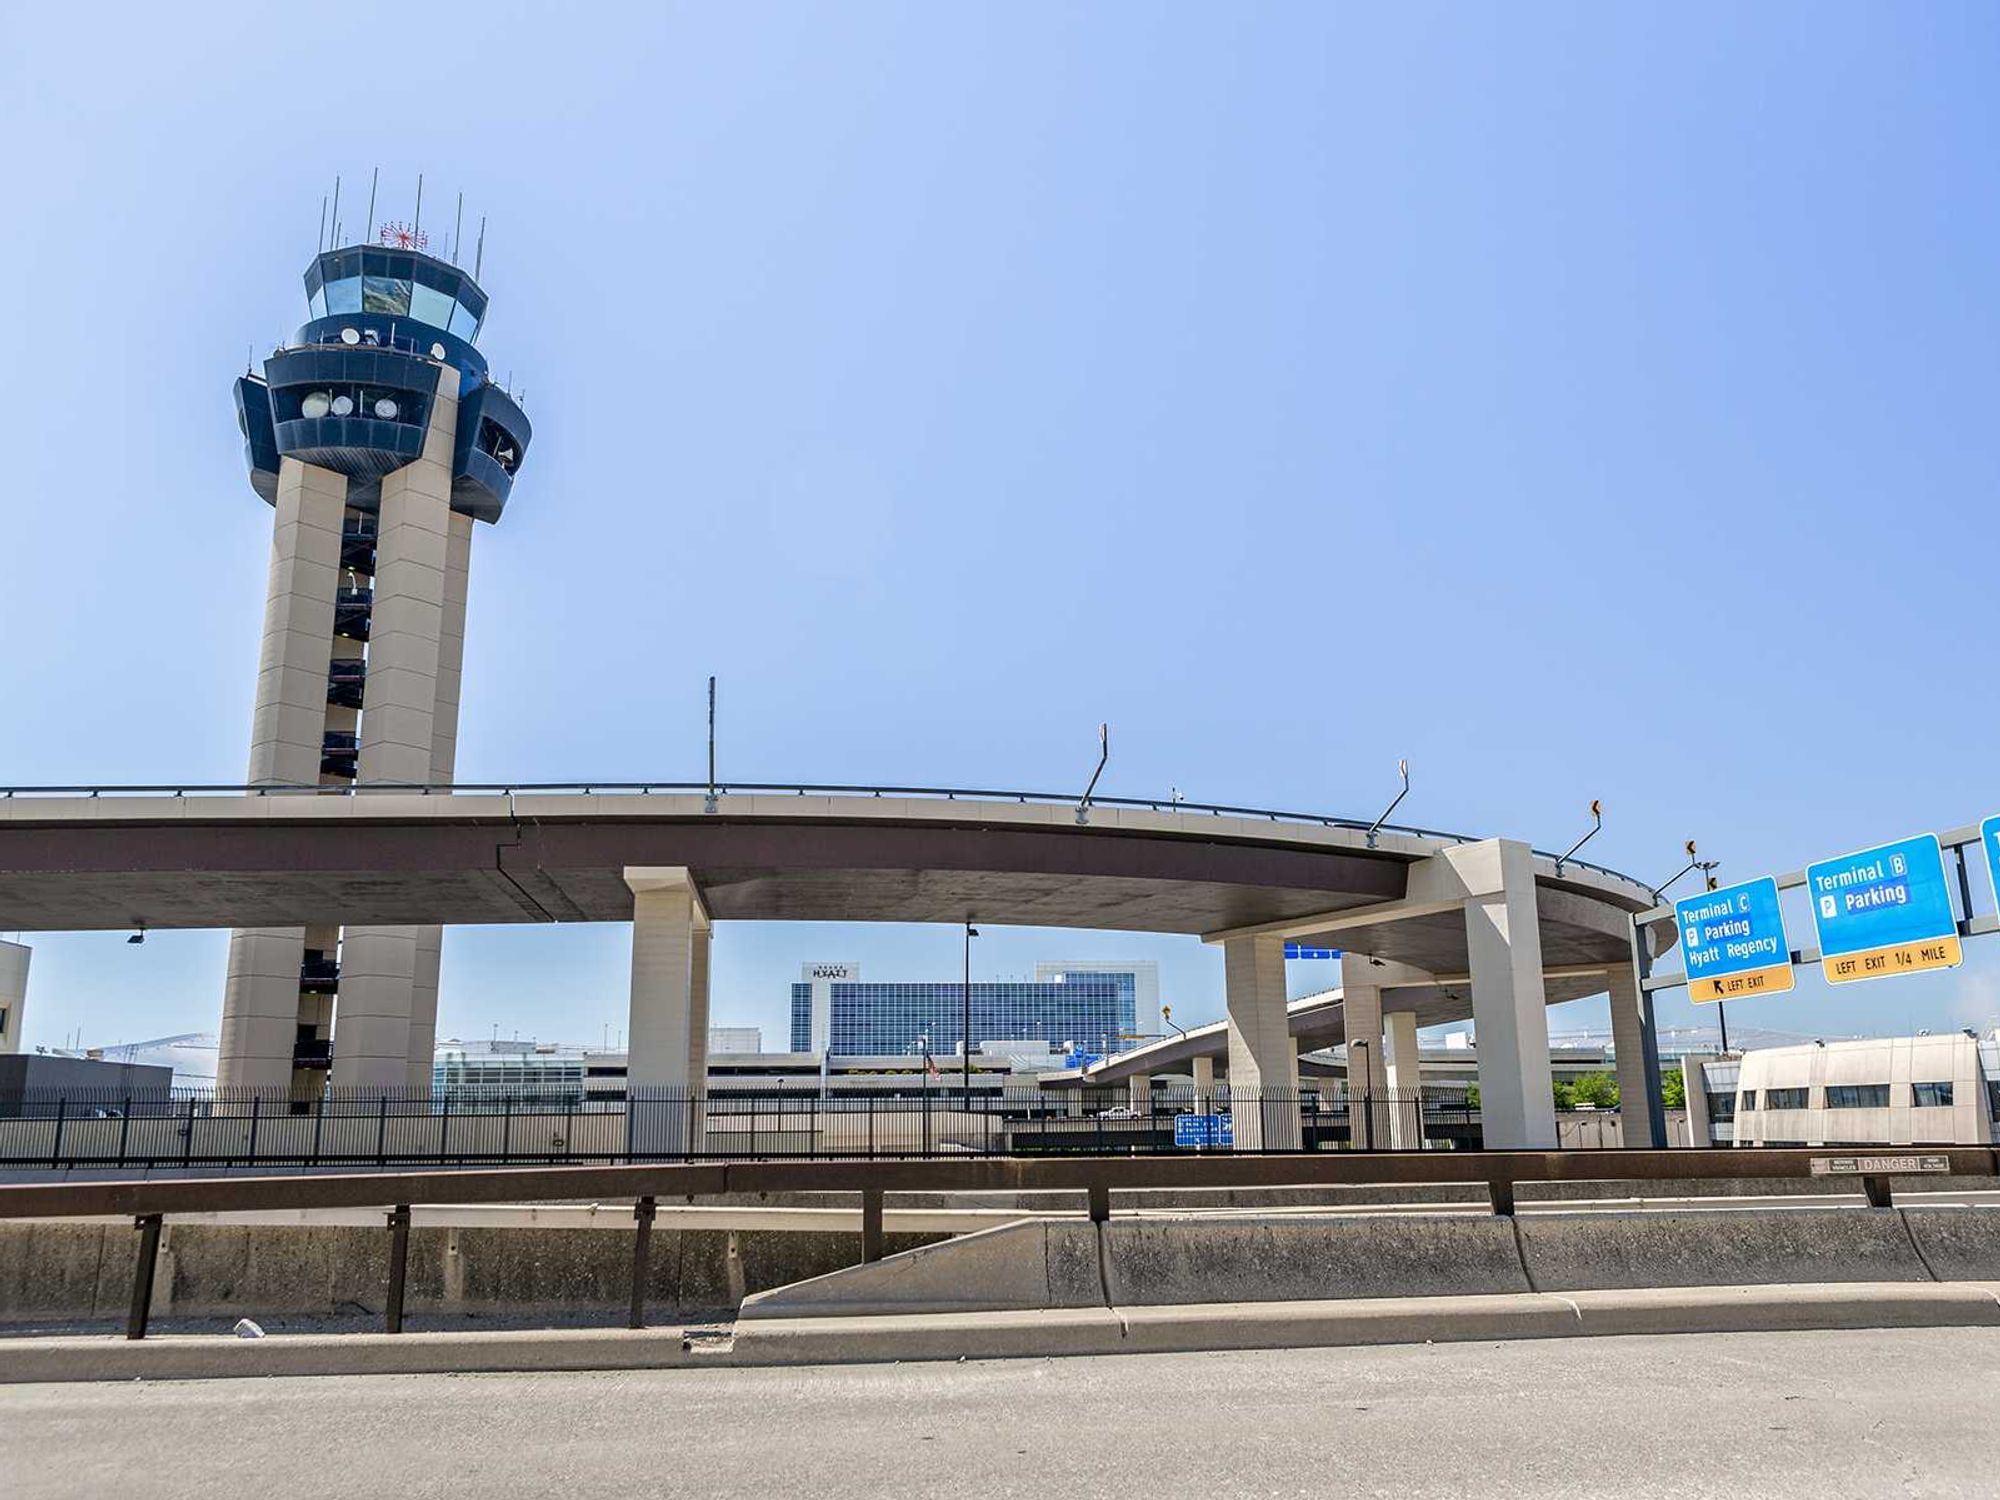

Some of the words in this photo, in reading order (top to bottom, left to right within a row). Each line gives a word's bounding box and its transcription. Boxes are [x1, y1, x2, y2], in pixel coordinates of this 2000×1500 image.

[1816, 860, 1884, 892] Terminal
[1893, 857, 1904, 874] B
[1682, 898, 1734, 924] Terminal
[1740, 895, 1748, 911] C
[1846, 885, 1906, 911] Parking
[1705, 920, 1750, 940] Parking
[1689, 946, 1720, 968] Hyatt
[1726, 936, 1777, 958] Regency
[1836, 961, 1856, 975] LEFT
[1865, 956, 1885, 970] EXIT
[1895, 952, 1912, 966] 1/4
[1921, 946, 1946, 961] MILE
[813, 970, 848, 979] HYATT
[1727, 979, 1744, 992] LEFT
[1748, 976, 1764, 988] EXIT
[1863, 1158, 1916, 1170] DANGER
